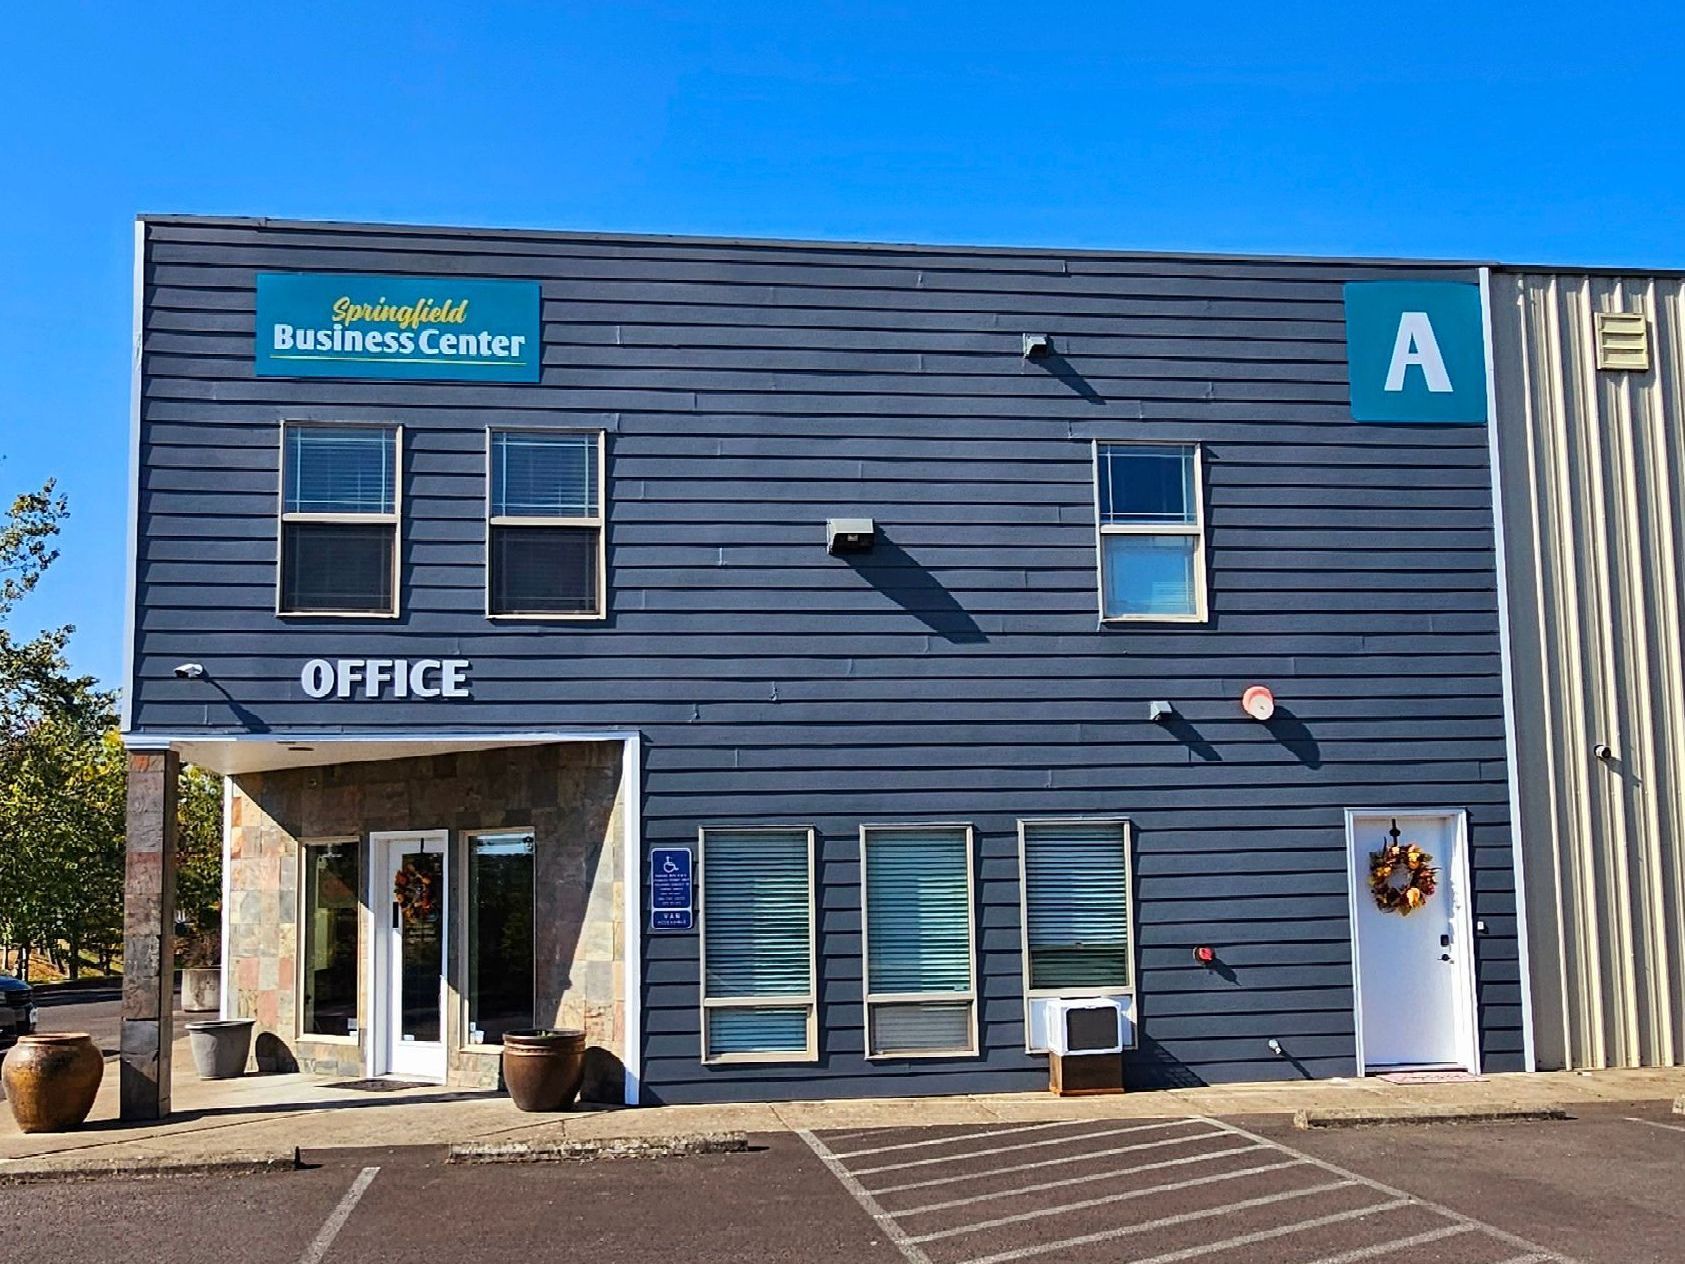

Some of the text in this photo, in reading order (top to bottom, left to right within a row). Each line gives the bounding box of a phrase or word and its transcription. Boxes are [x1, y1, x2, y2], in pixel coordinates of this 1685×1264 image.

[332, 296, 469, 329] Springfield
[274, 323, 526, 357] Business Center
[1384, 312, 1454, 392] A
[301, 658, 470, 698] OFFICE
